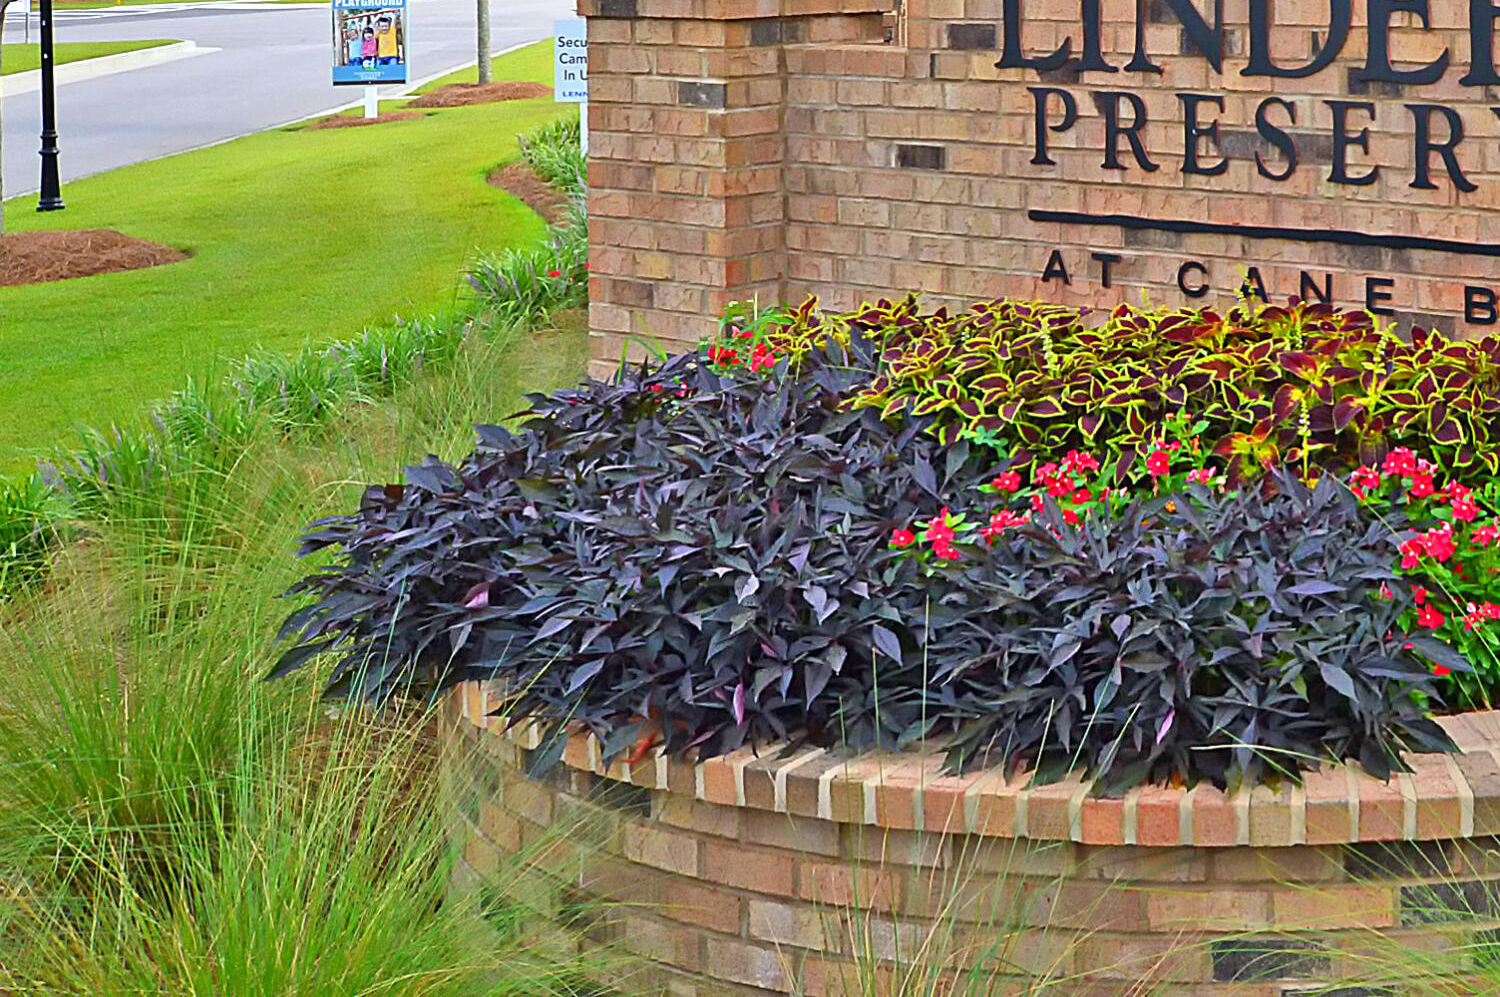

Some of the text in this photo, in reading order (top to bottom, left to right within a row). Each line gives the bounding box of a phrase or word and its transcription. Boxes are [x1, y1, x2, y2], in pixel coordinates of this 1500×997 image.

[564, 69, 575, 81] In
[1041, 249, 1121, 289] AT
[1176, 261, 1394, 316] CANE
